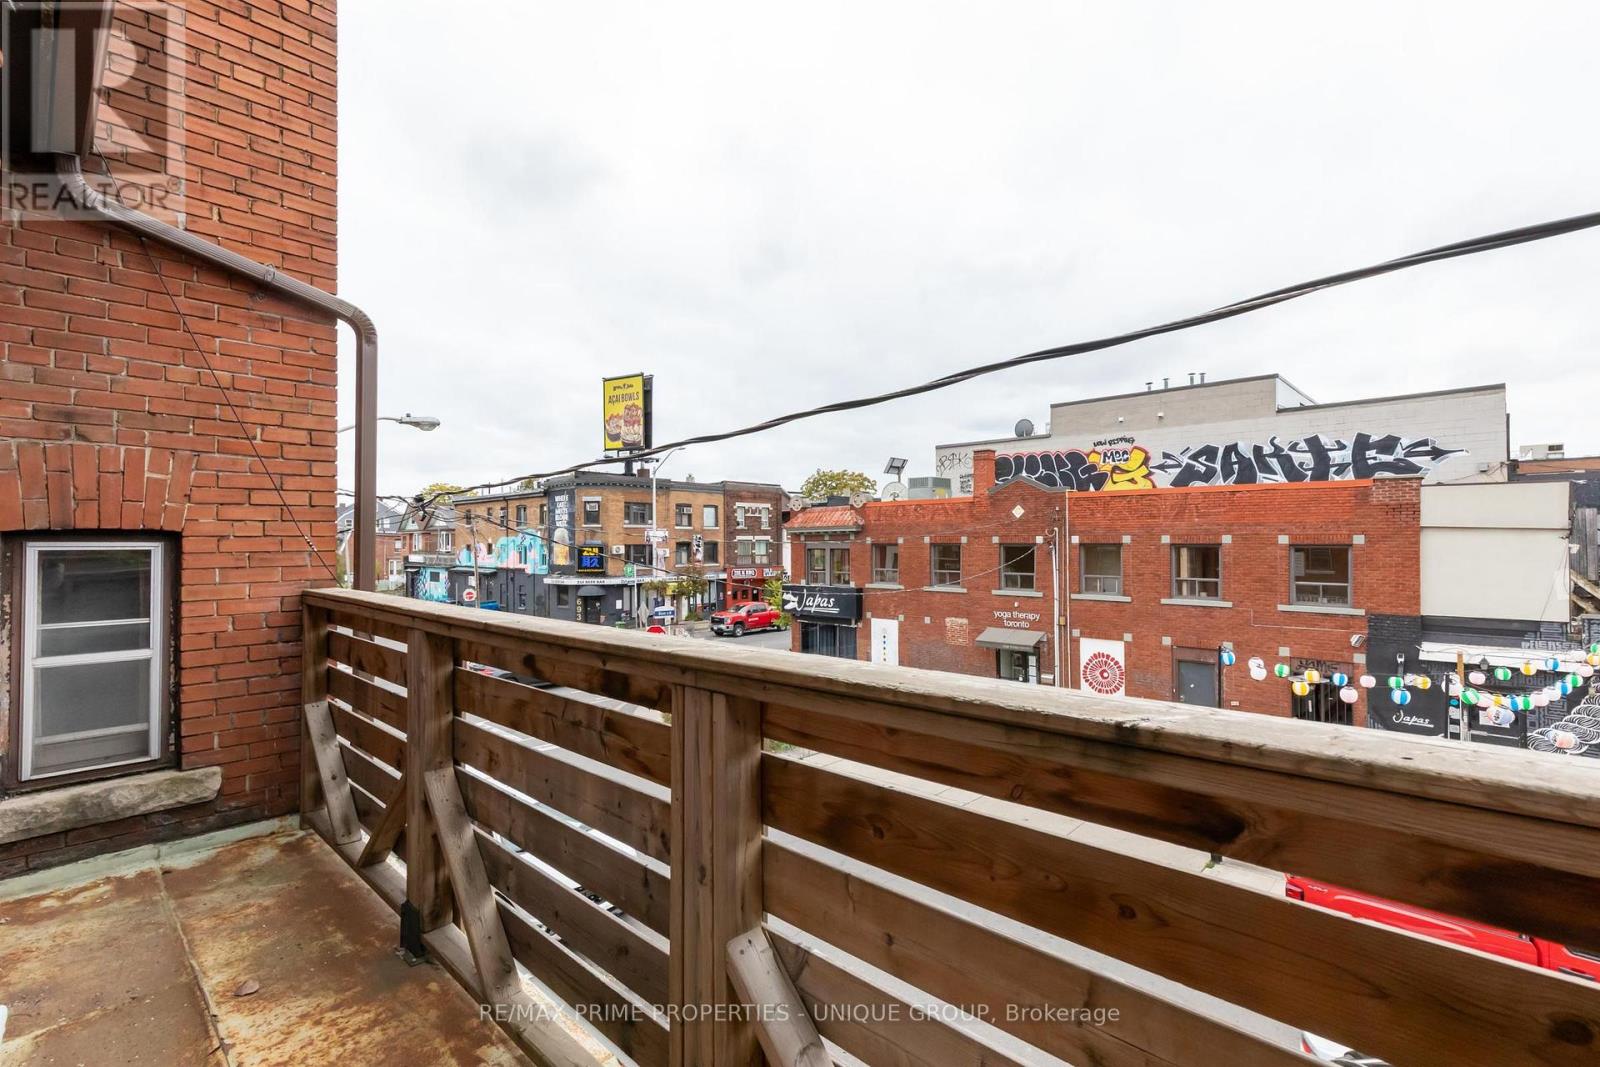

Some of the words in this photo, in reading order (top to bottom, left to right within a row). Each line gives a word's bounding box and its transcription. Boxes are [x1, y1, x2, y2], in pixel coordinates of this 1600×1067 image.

[993, 611, 1011, 619] yoga
[1012, 611, 1041, 621] therapy
[1003, 619, 1030, 628] toronto
[1393, 710, 1431, 725] Japas
